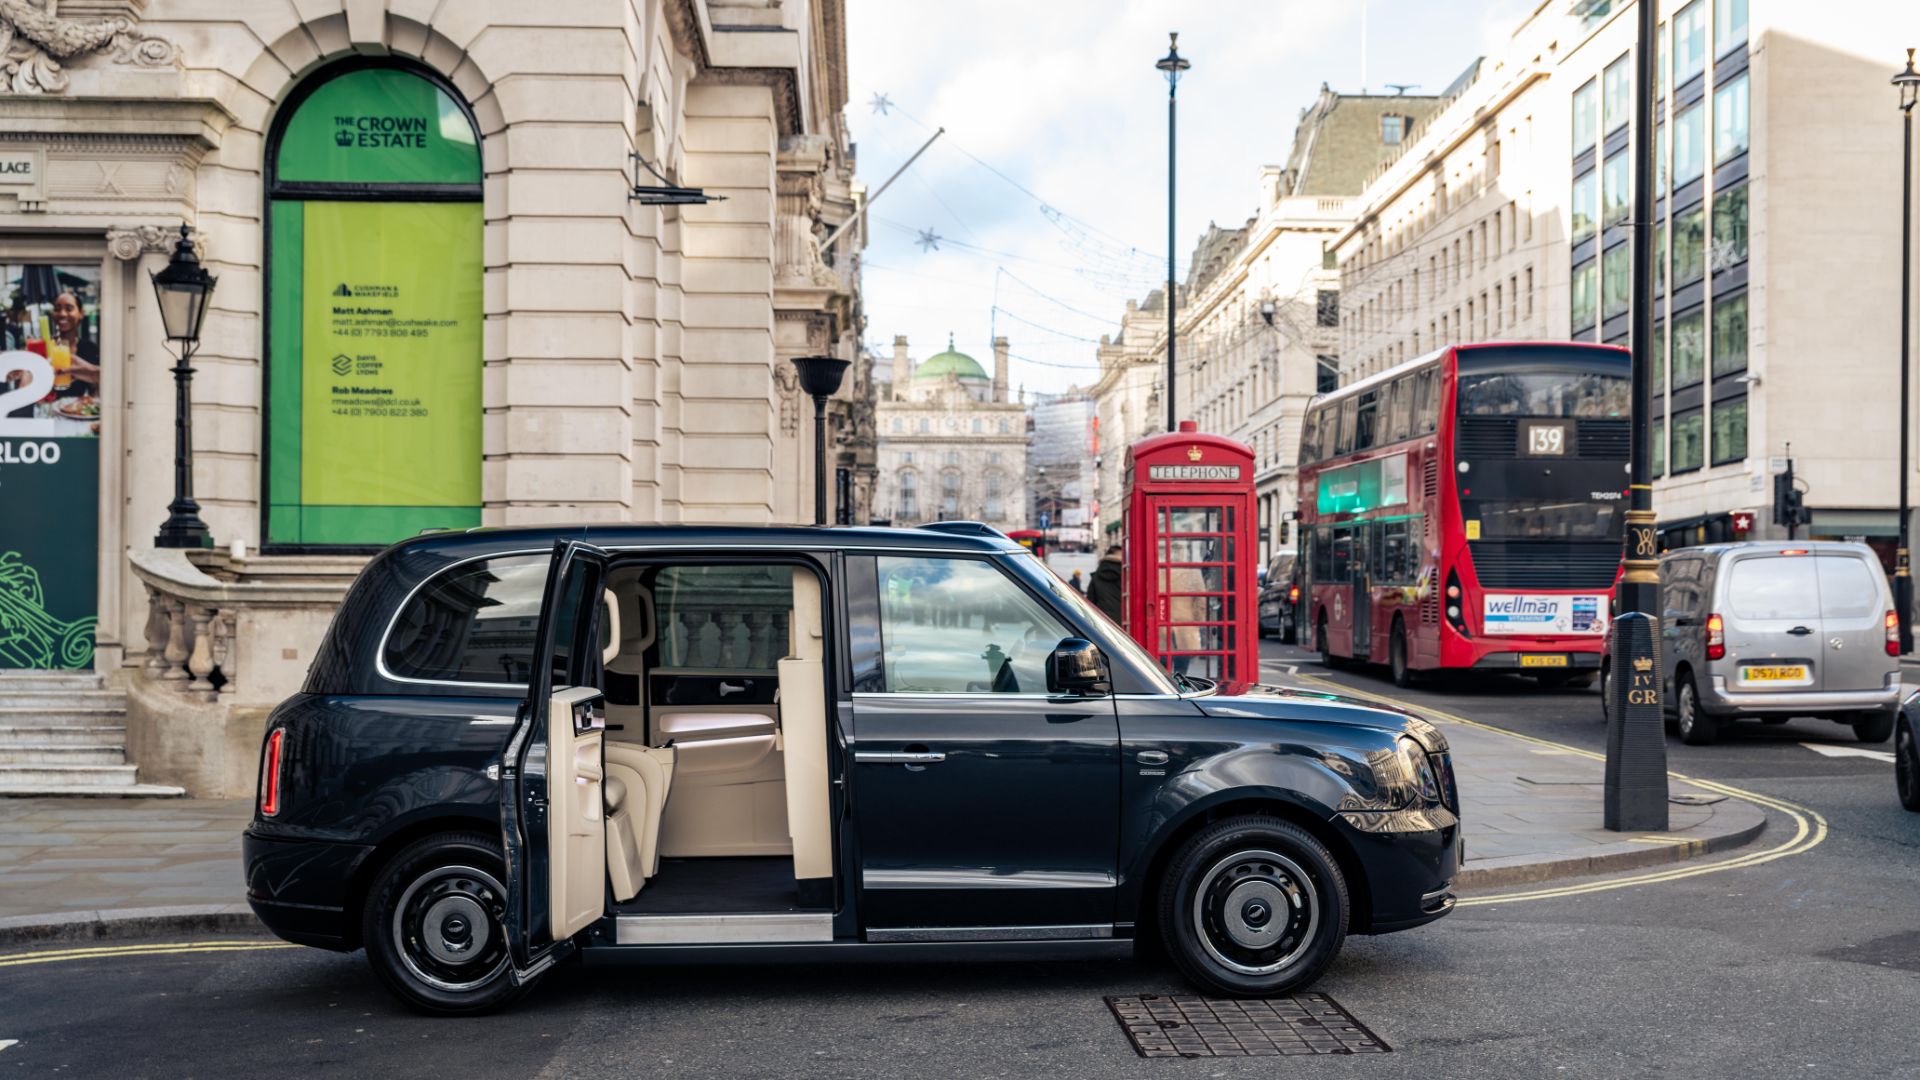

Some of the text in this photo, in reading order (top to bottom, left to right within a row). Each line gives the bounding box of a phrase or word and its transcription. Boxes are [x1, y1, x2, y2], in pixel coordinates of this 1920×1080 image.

[334, 116, 427, 132] THE CROWN
[358, 133, 427, 148] ESTATE
[0, 161, 31, 174] LACE
[332, 307, 393, 315] Matt Ashman
[332, 328, 349, 336] +44
[351, 328, 362, 338] (0)
[365, 328, 388, 337] 7793
[332, 386, 393, 395] Rob Meadows
[332, 409, 348, 417] +44
[350, 408, 362, 418] (0)
[364, 409, 388, 417] 7900
[1529, 427, 1561, 452] 139
[0, 441, 61, 464] LOO
[1154, 466, 1237, 479] TELEPHONE
[1488, 596, 1559, 614] wellman
[1634, 676, 1653, 686] IV
[1628, 690, 1657, 704] GR
